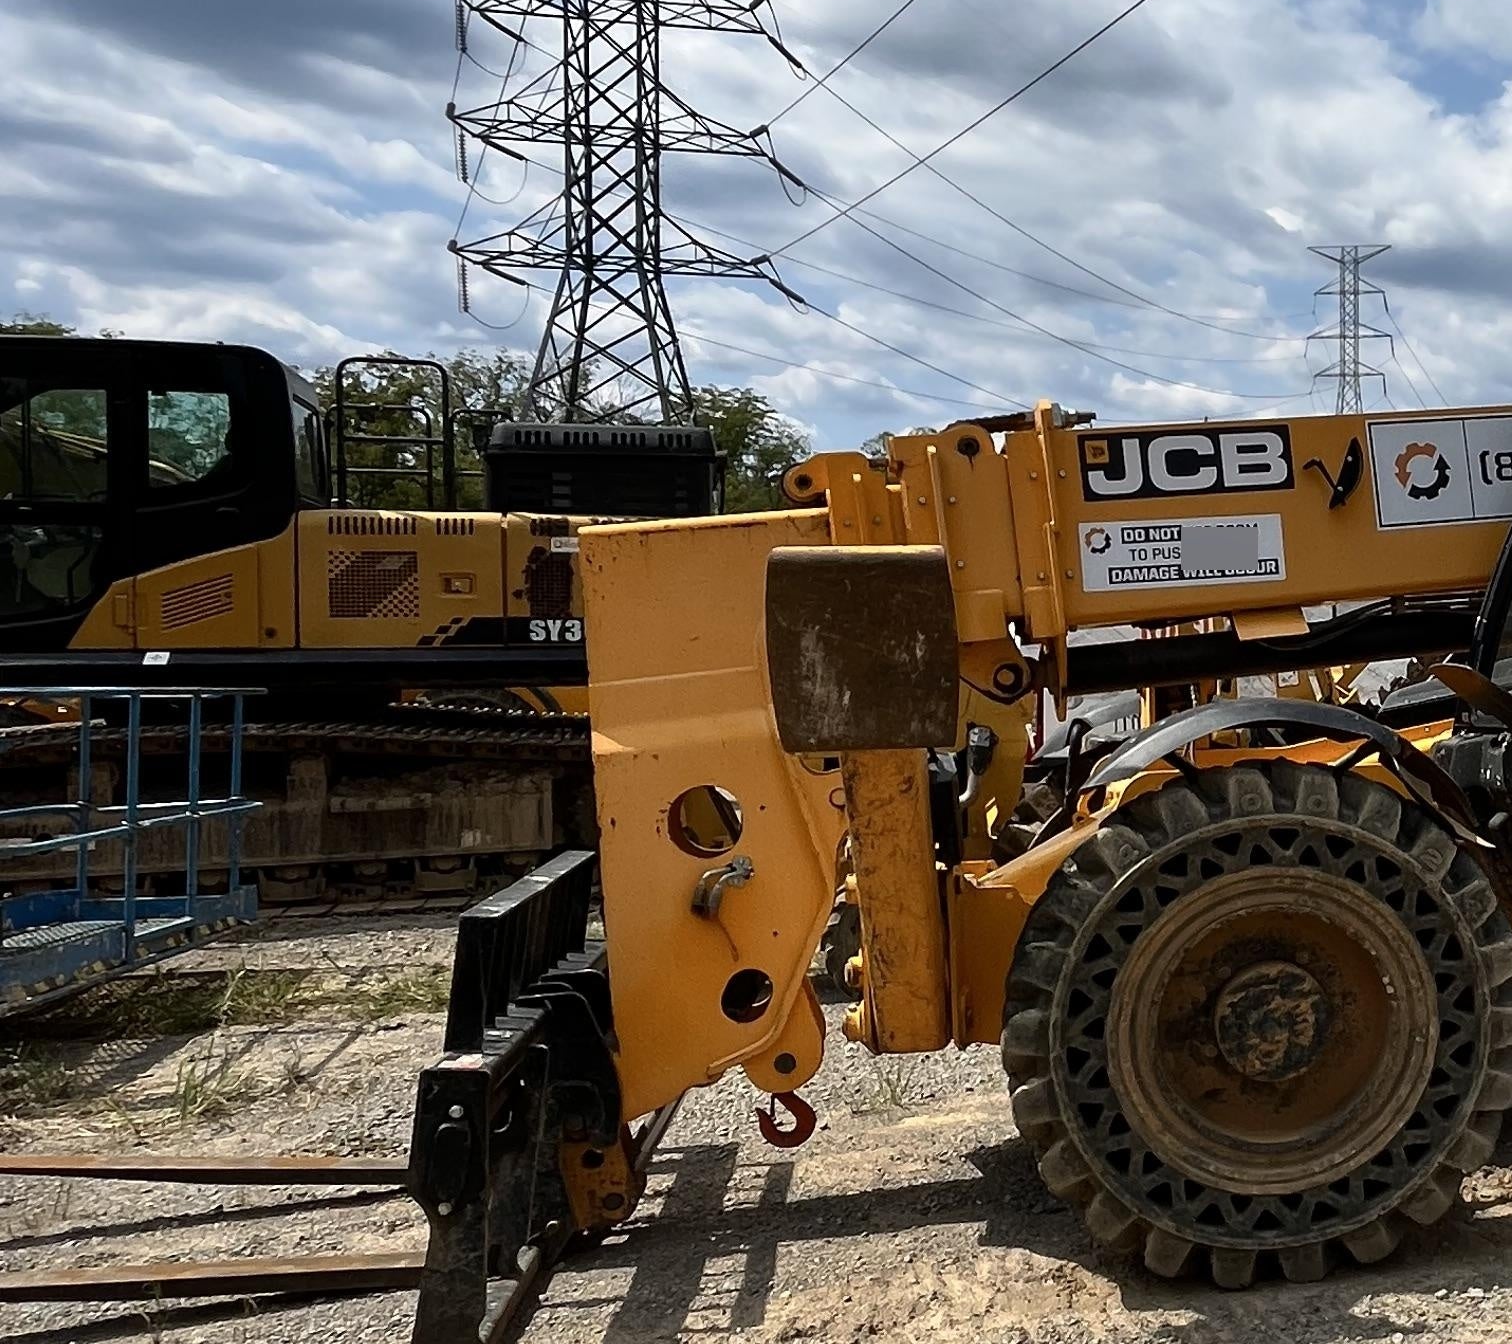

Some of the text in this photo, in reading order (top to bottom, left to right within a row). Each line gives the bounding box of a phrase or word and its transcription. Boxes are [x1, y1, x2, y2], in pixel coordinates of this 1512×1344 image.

[1087, 431, 1288, 495] JCB
[1123, 527, 1180, 542] DO NOT
[1128, 546, 1181, 562] TO PUS
[1111, 566, 1179, 583] DAMAGE
[529, 619, 582, 641] SY3
